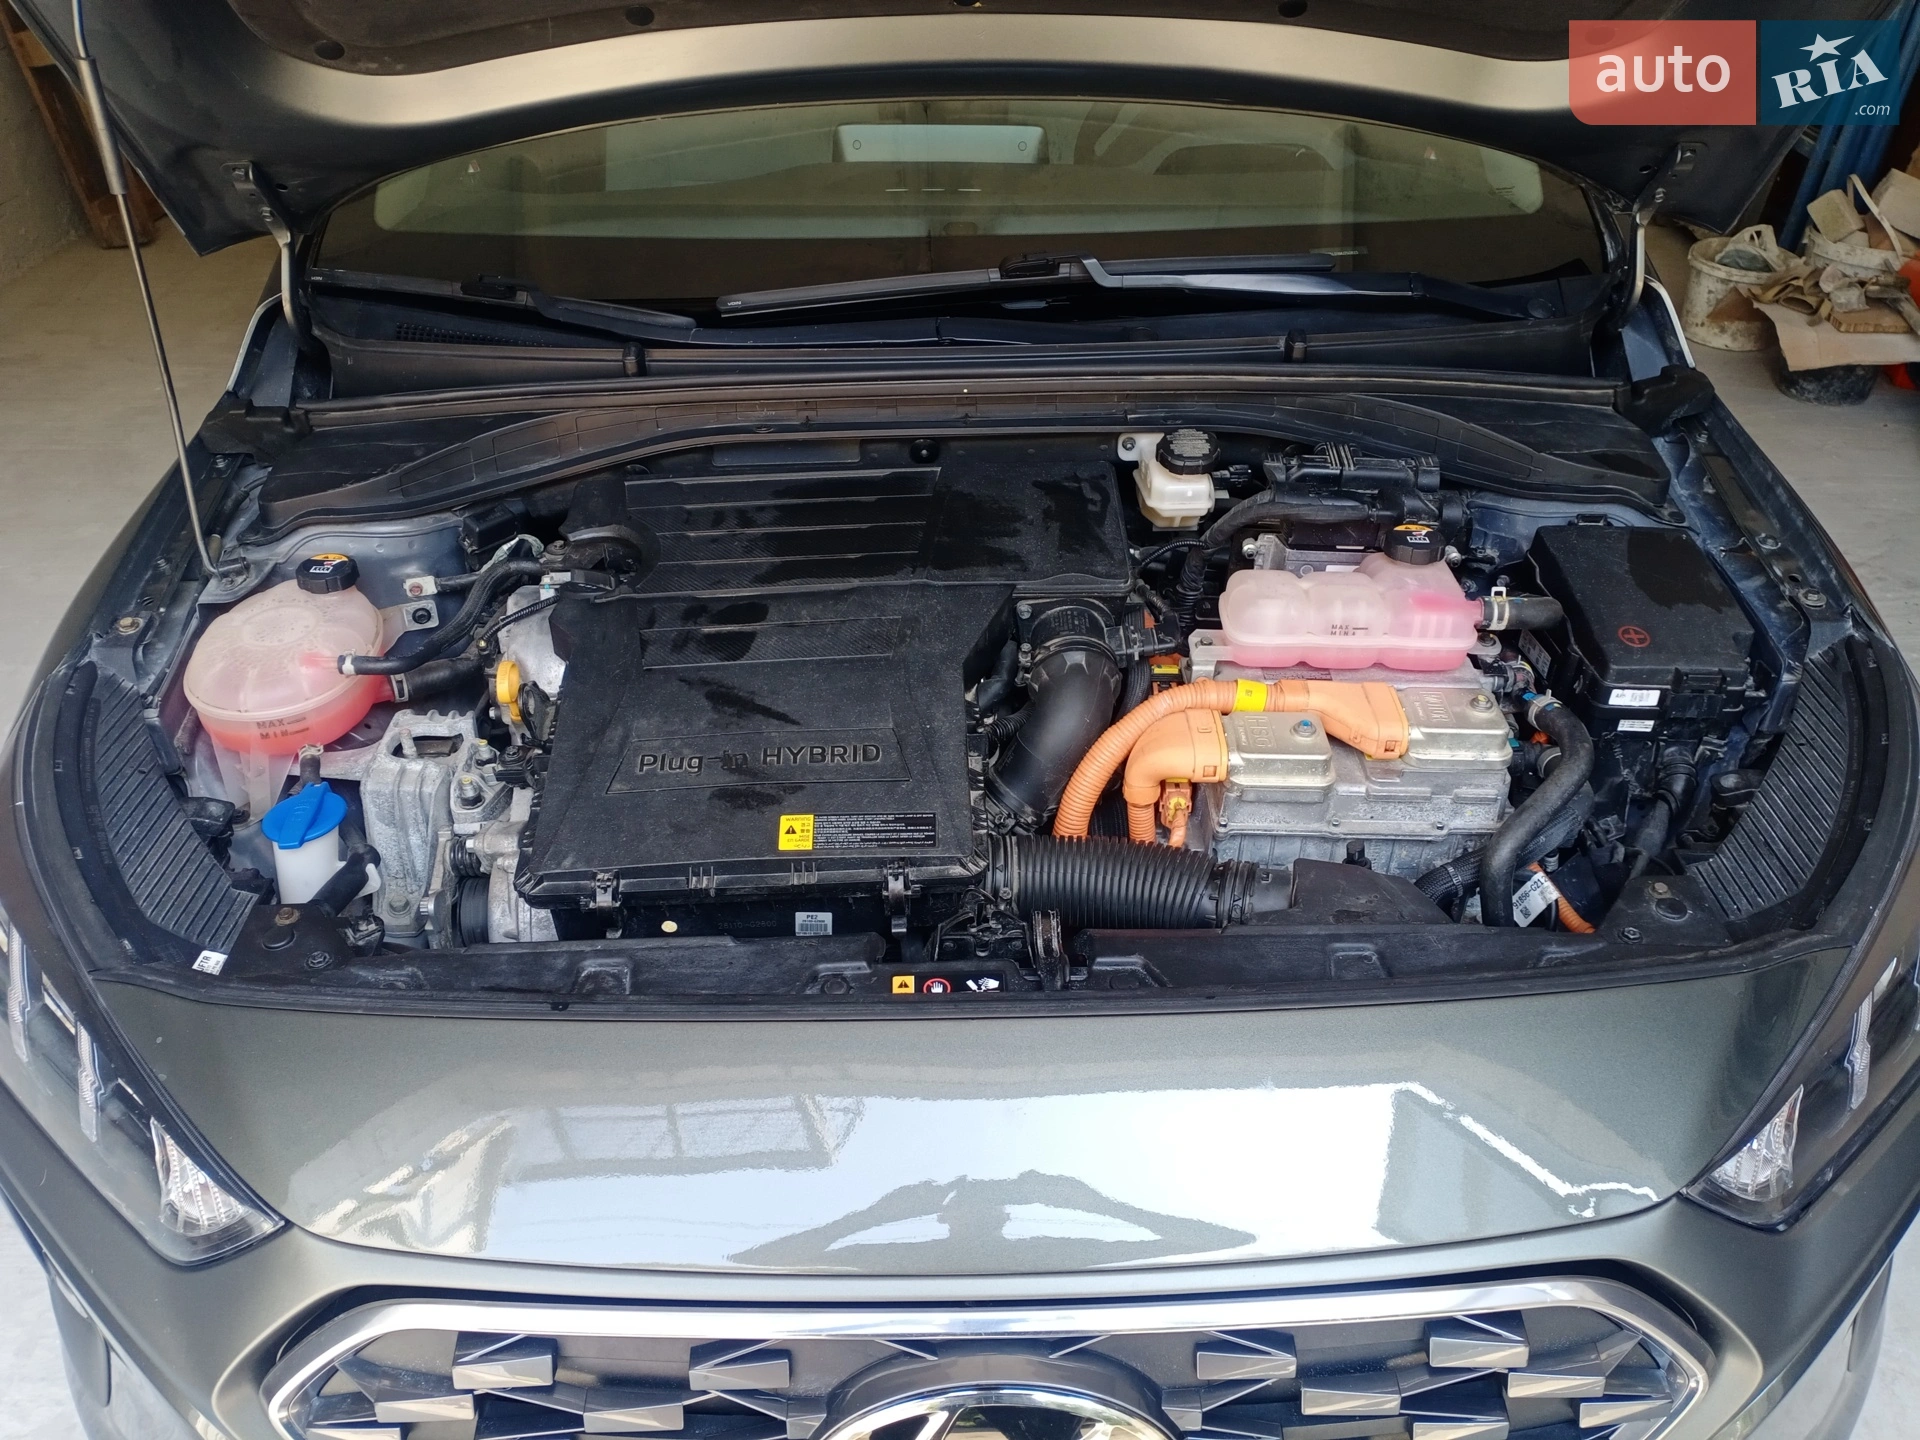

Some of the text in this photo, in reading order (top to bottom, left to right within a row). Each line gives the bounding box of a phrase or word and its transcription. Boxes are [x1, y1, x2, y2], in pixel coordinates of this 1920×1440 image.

[256, 719, 285, 730] MAX
[260, 729, 289, 740] MIN
[637, 744, 882, 774] Plug-in HYBRID
